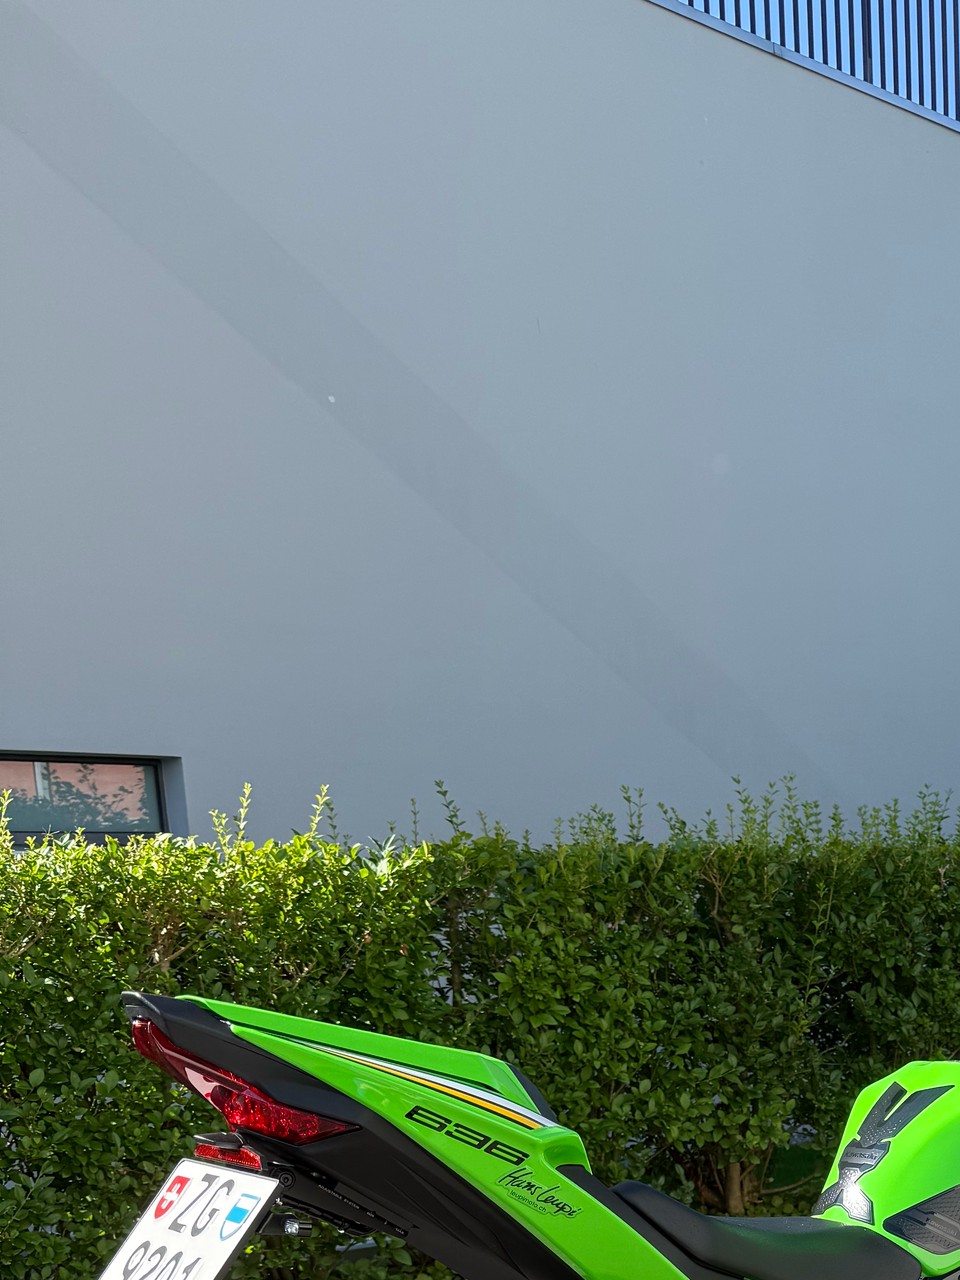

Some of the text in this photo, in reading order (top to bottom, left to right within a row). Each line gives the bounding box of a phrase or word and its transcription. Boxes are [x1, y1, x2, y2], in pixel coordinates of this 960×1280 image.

[405, 1105, 530, 1166] 636
[168, 1173, 235, 1237] ZG
[498, 1168, 582, 1216] Hans Leupi
